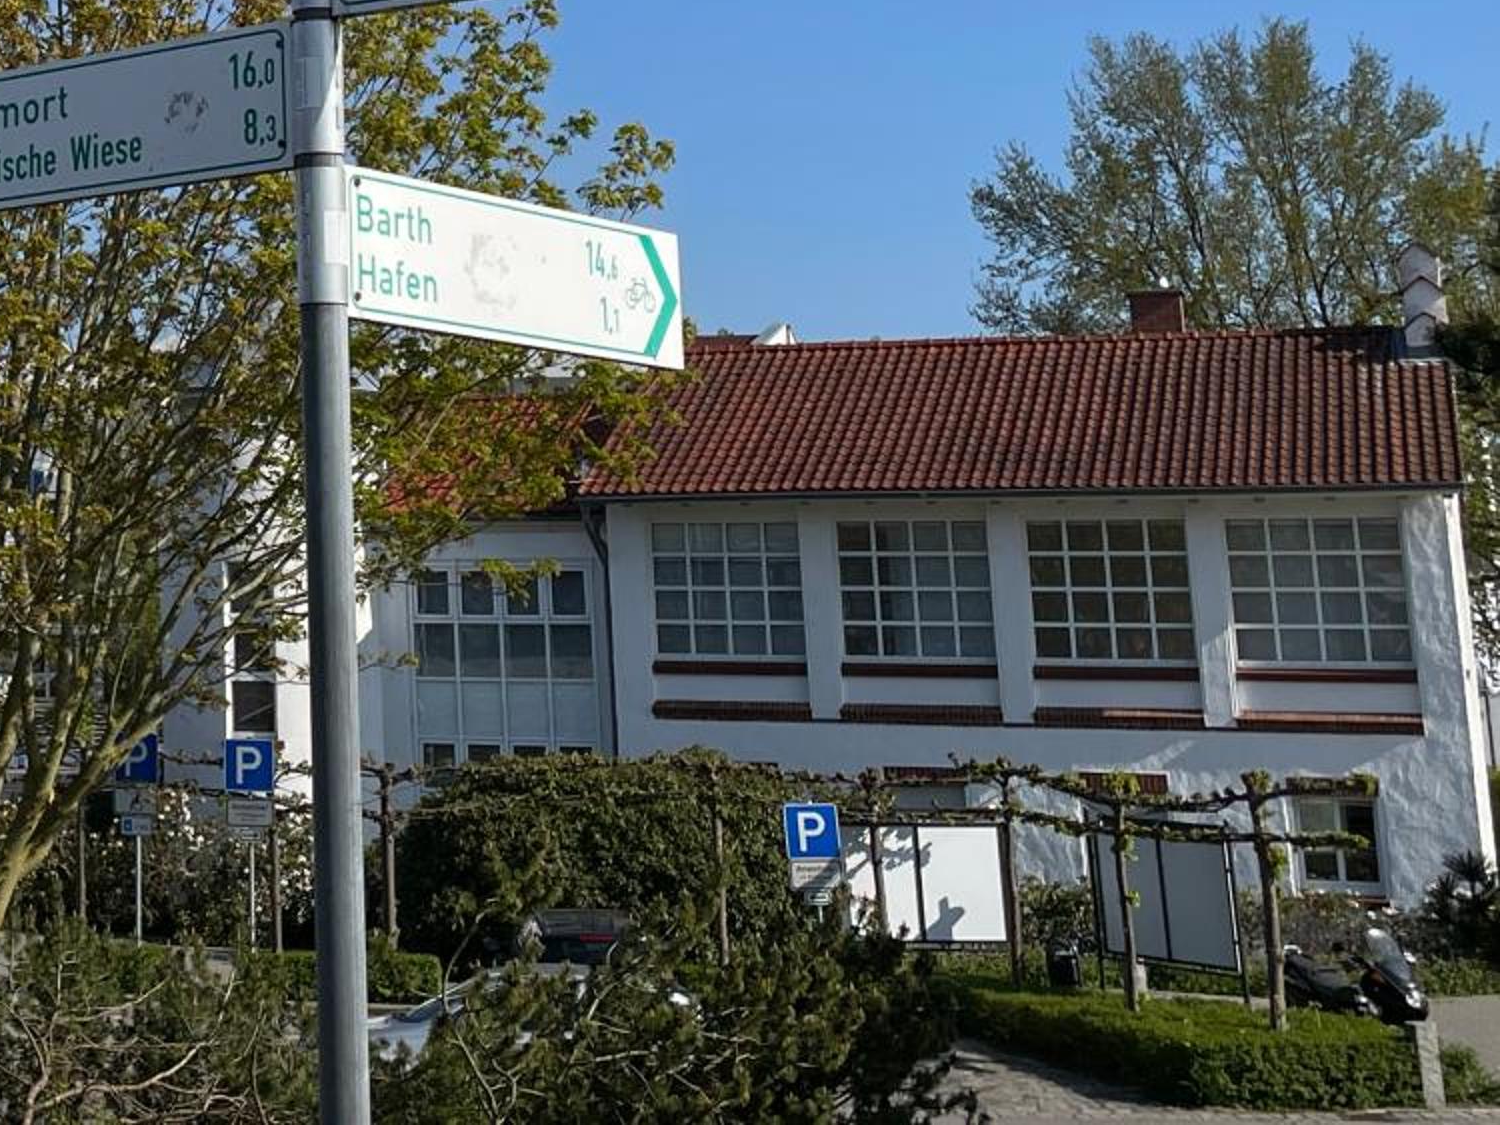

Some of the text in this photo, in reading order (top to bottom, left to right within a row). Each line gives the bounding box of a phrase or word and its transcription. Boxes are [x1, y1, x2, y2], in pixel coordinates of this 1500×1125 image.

[228, 50, 275, 91] 16,0
[70, 132, 142, 171] Wiese
[244, 109, 277, 145] 8,3
[357, 194, 432, 244] Barth
[357, 254, 437, 302] Hafen
[124, 741, 148, 777] P
[235, 746, 262, 785] P
[797, 811, 826, 853] P
